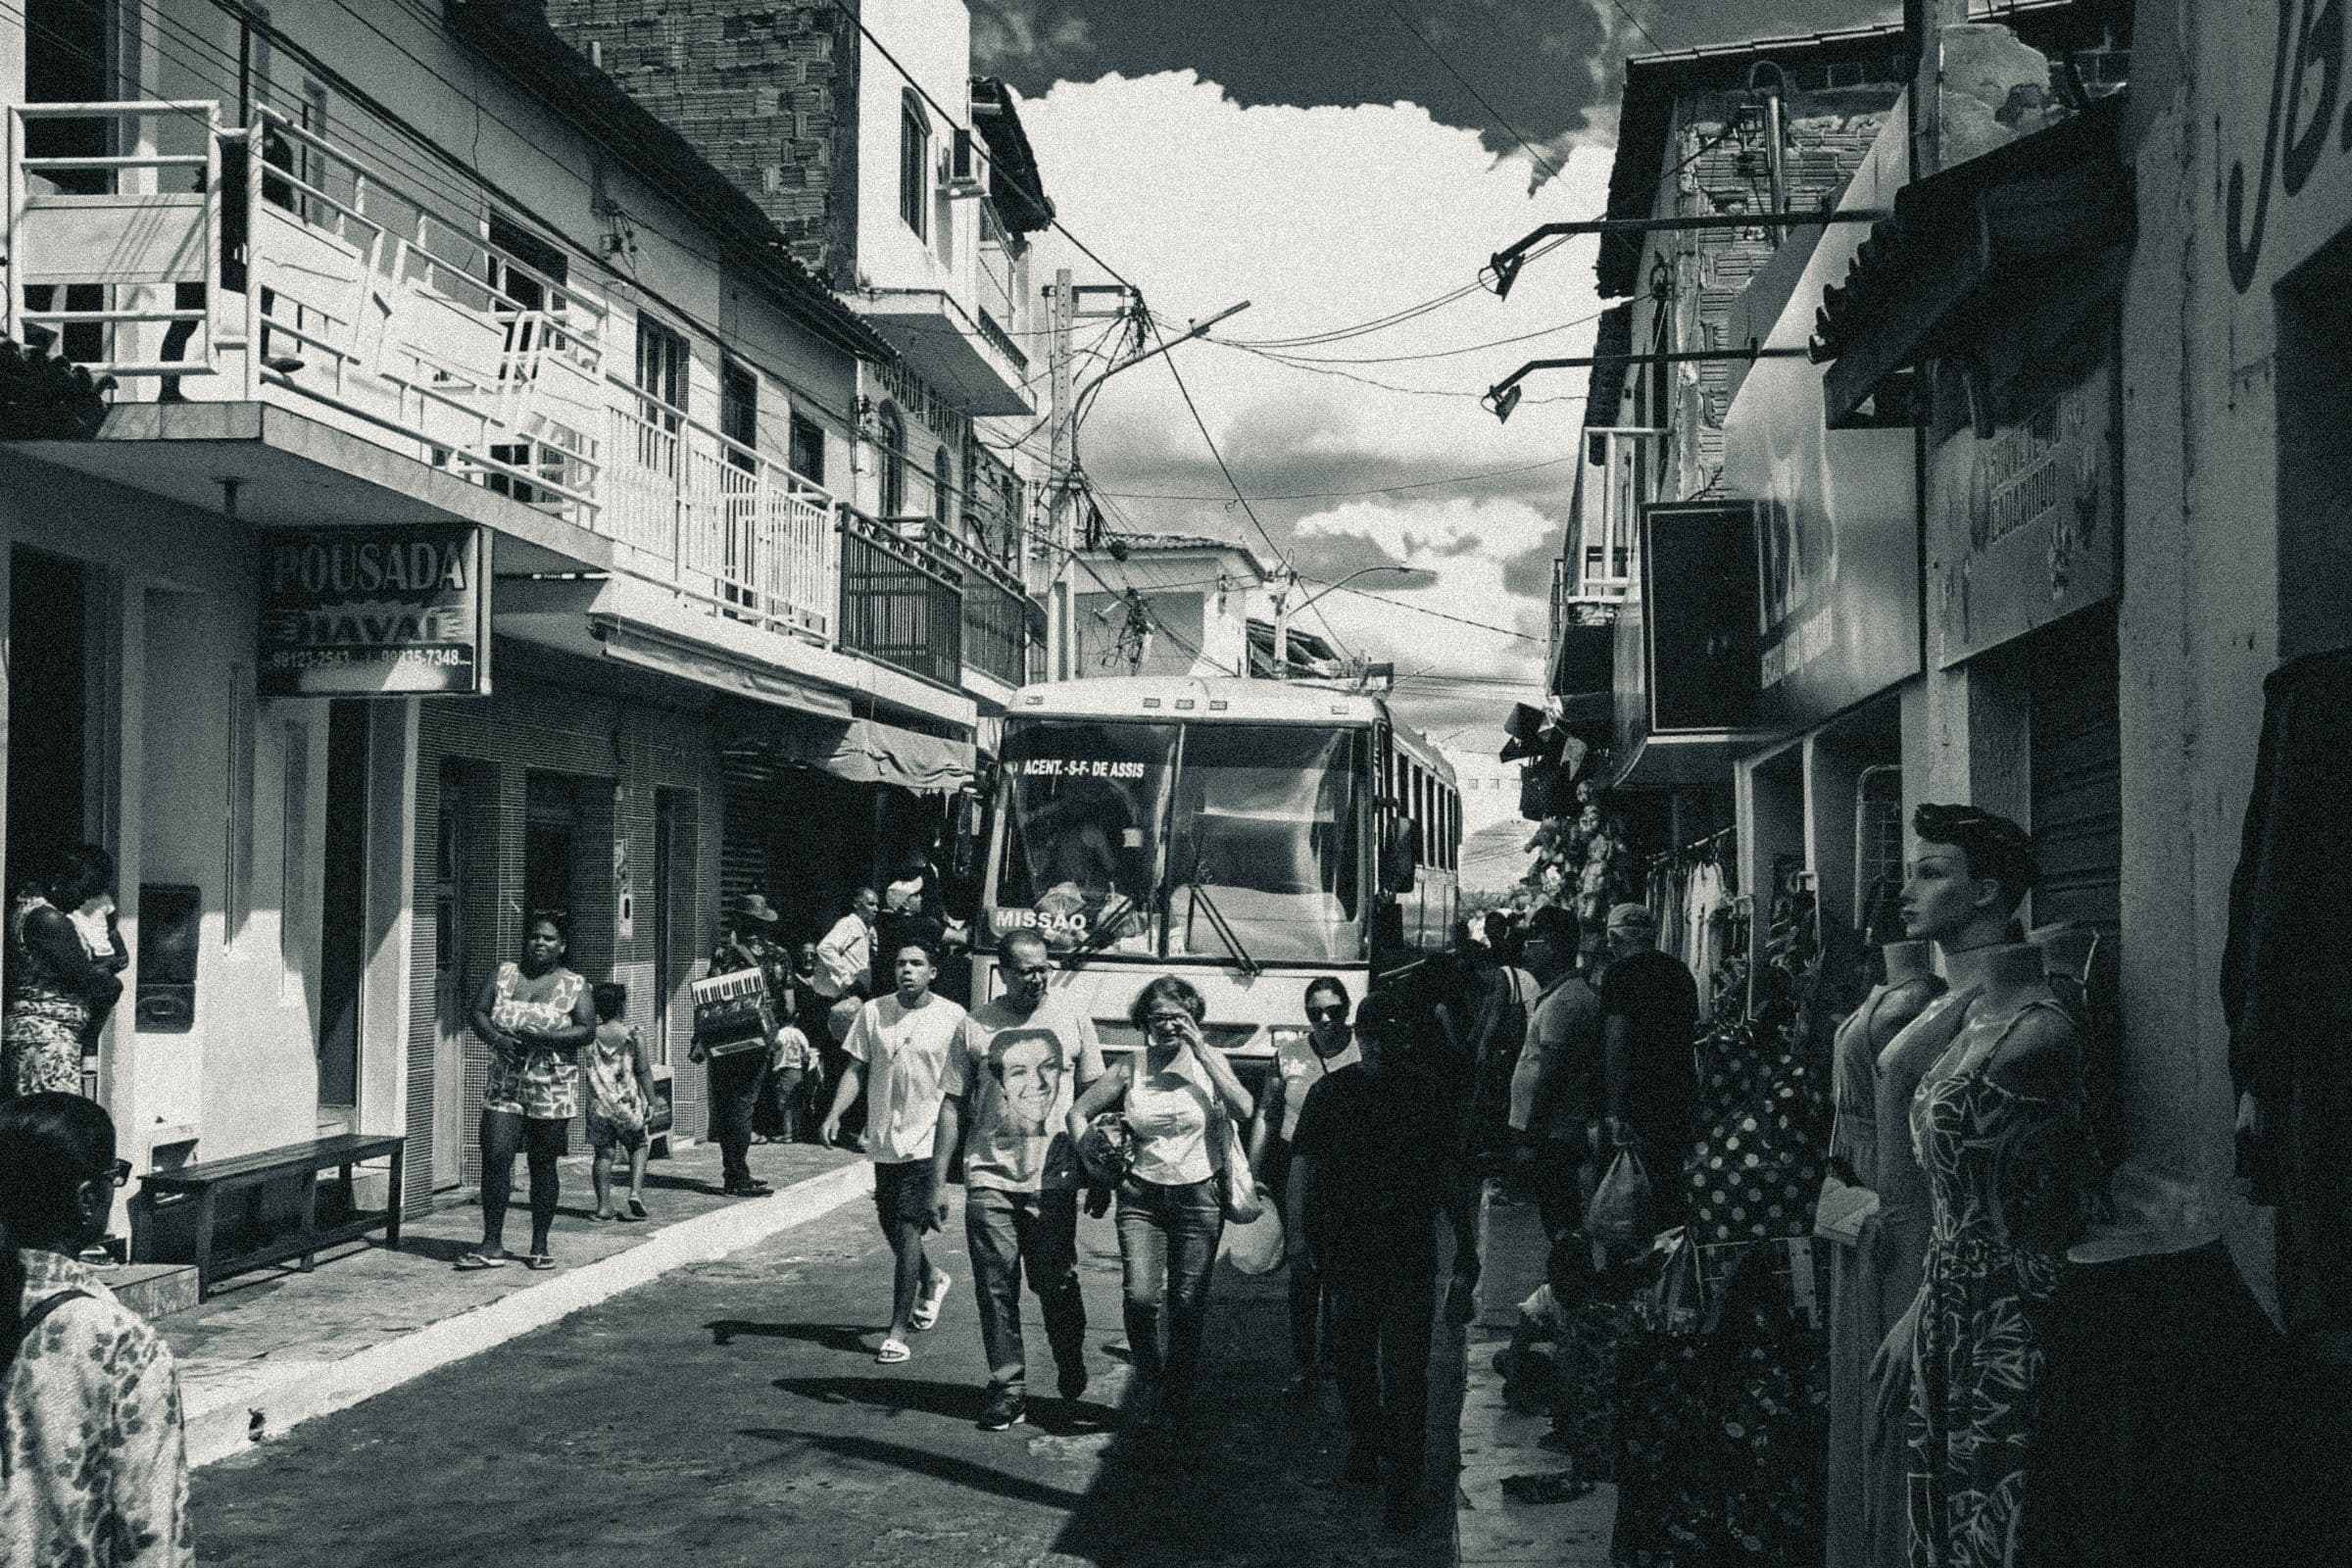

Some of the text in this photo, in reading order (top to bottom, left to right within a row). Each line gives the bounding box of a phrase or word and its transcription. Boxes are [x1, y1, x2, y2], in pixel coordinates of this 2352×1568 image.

[273, 542, 467, 593] POUSADA
[1092, 760, 1108, 776] DE
[1110, 761, 1145, 778] ASSIS
